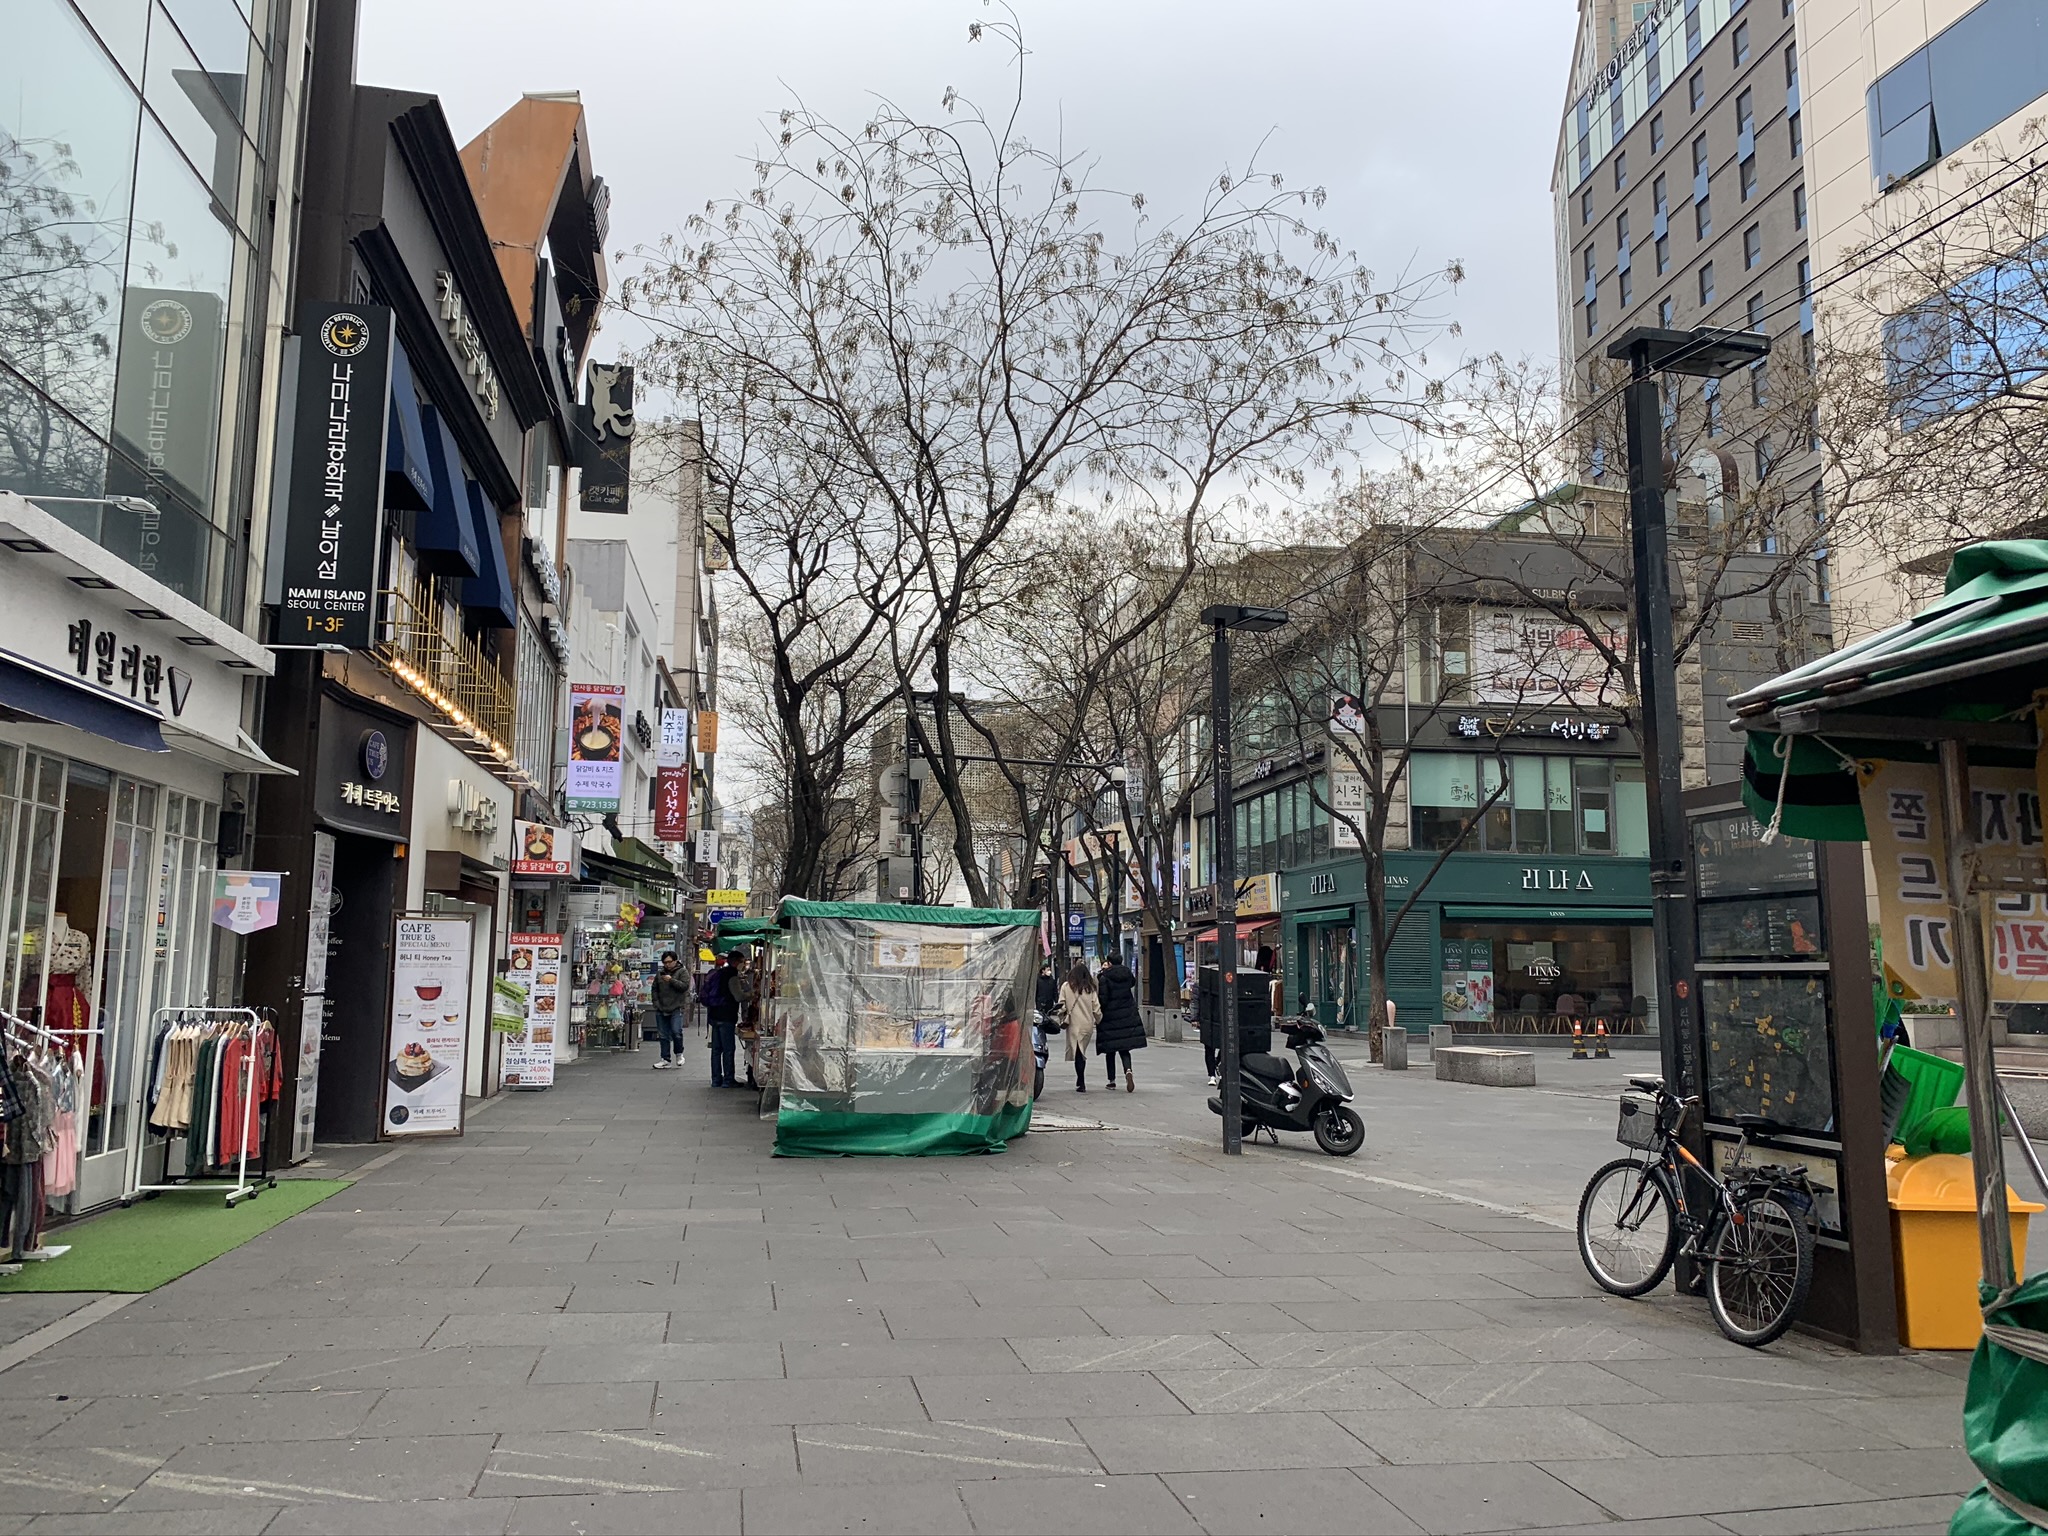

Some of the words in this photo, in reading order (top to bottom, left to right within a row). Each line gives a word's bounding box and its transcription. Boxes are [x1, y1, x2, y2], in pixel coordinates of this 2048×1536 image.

[1597, 24, 1648, 95] HOTEL
[589, 495, 602, 503] Cat
[317, 519, 343, 580] 남이섬
[288, 588, 321, 600] NAMI
[323, 589, 366, 601] ISLAND
[1531, 588, 1577, 600] SULBING
[287, 599, 321, 610] SEOUL
[323, 600, 365, 611] CENTER
[572, 684, 592, 692] 인사동
[593, 685, 613, 693] 닭갈비
[1550, 717, 1585, 740] 설빙
[575, 765, 595, 773] 닭갈비
[601, 765, 615, 774] 치즈
[340, 781, 364, 807] 카페
[1335, 784, 1363, 799] 시작
[581, 800, 618, 809] 723.1339
[1728, 820, 1761, 839] 인사동
[529, 861, 554, 872] 닭갈비
[1521, 868, 1594, 890] 리나스
[400, 923, 432, 933] CAFE
[400, 933, 422, 941] TRUE
[512, 935, 531, 943] 인사동
